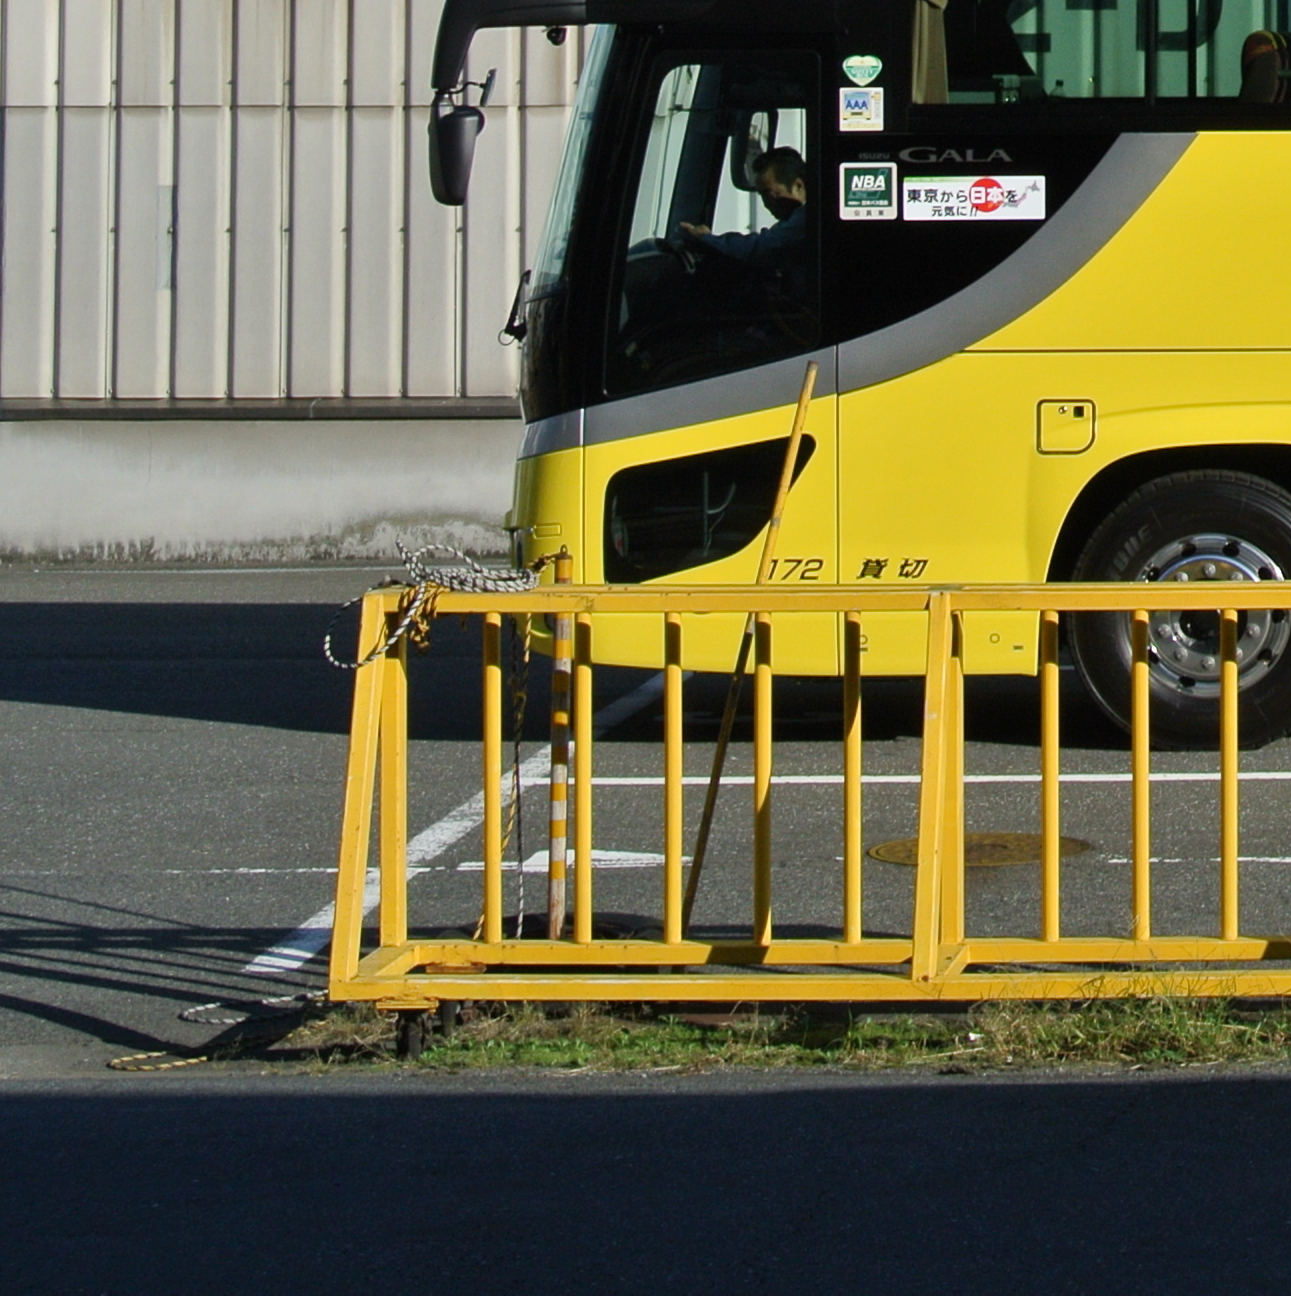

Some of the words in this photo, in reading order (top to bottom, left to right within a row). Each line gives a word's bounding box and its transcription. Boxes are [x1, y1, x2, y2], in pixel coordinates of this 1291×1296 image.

[845, 99, 869, 110] AAA
[858, 152, 890, 160] ISUZU
[898, 146, 1013, 163] GALA
[851, 175, 886, 190] NBA
[906, 186, 1018, 205] 東京から日本を
[768, 559, 824, 581] 172
